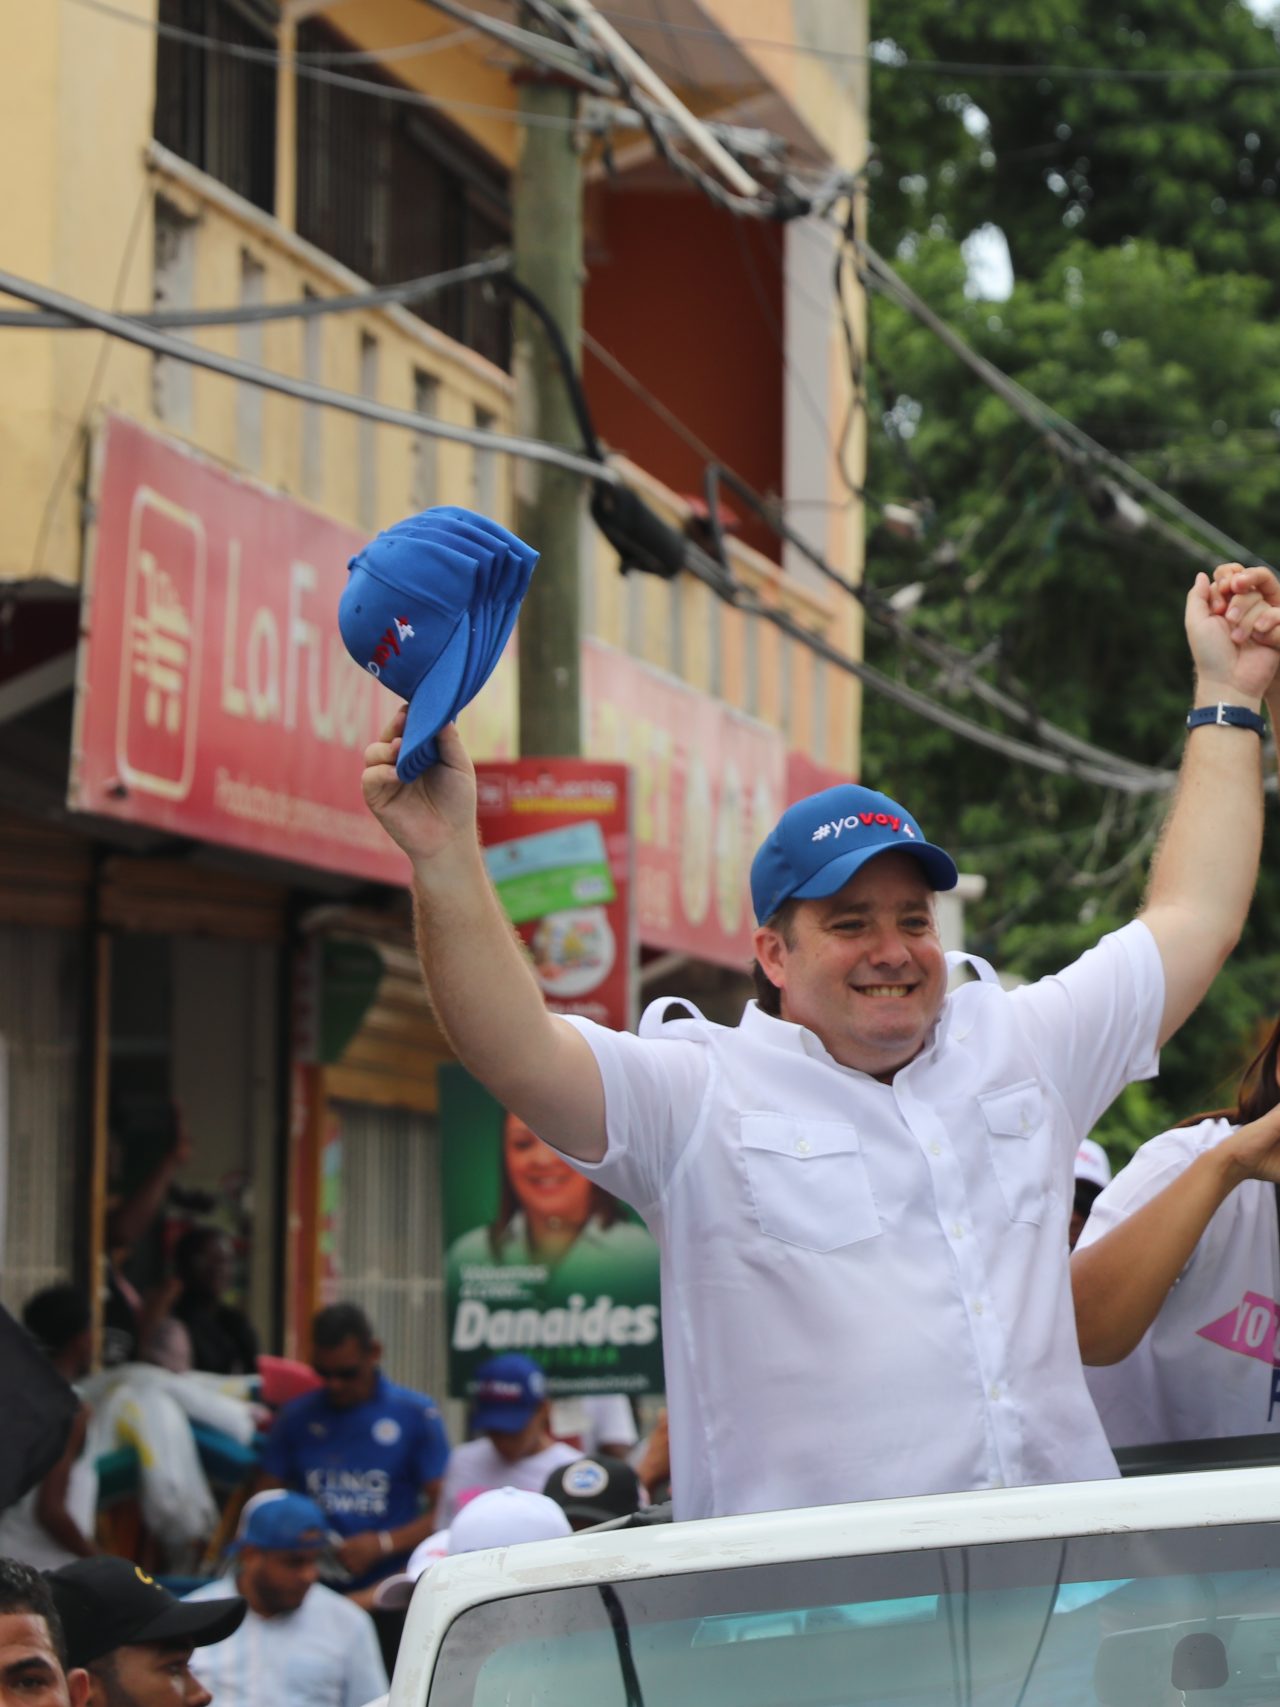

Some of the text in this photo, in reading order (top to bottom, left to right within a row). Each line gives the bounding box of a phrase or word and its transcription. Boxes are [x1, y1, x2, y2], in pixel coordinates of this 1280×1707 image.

[221, 538, 394, 751] LaFue
[452, 1294, 659, 1351] Danaides
[305, 1468, 390, 1492] KING
[321, 1491, 387, 1516] OWER
